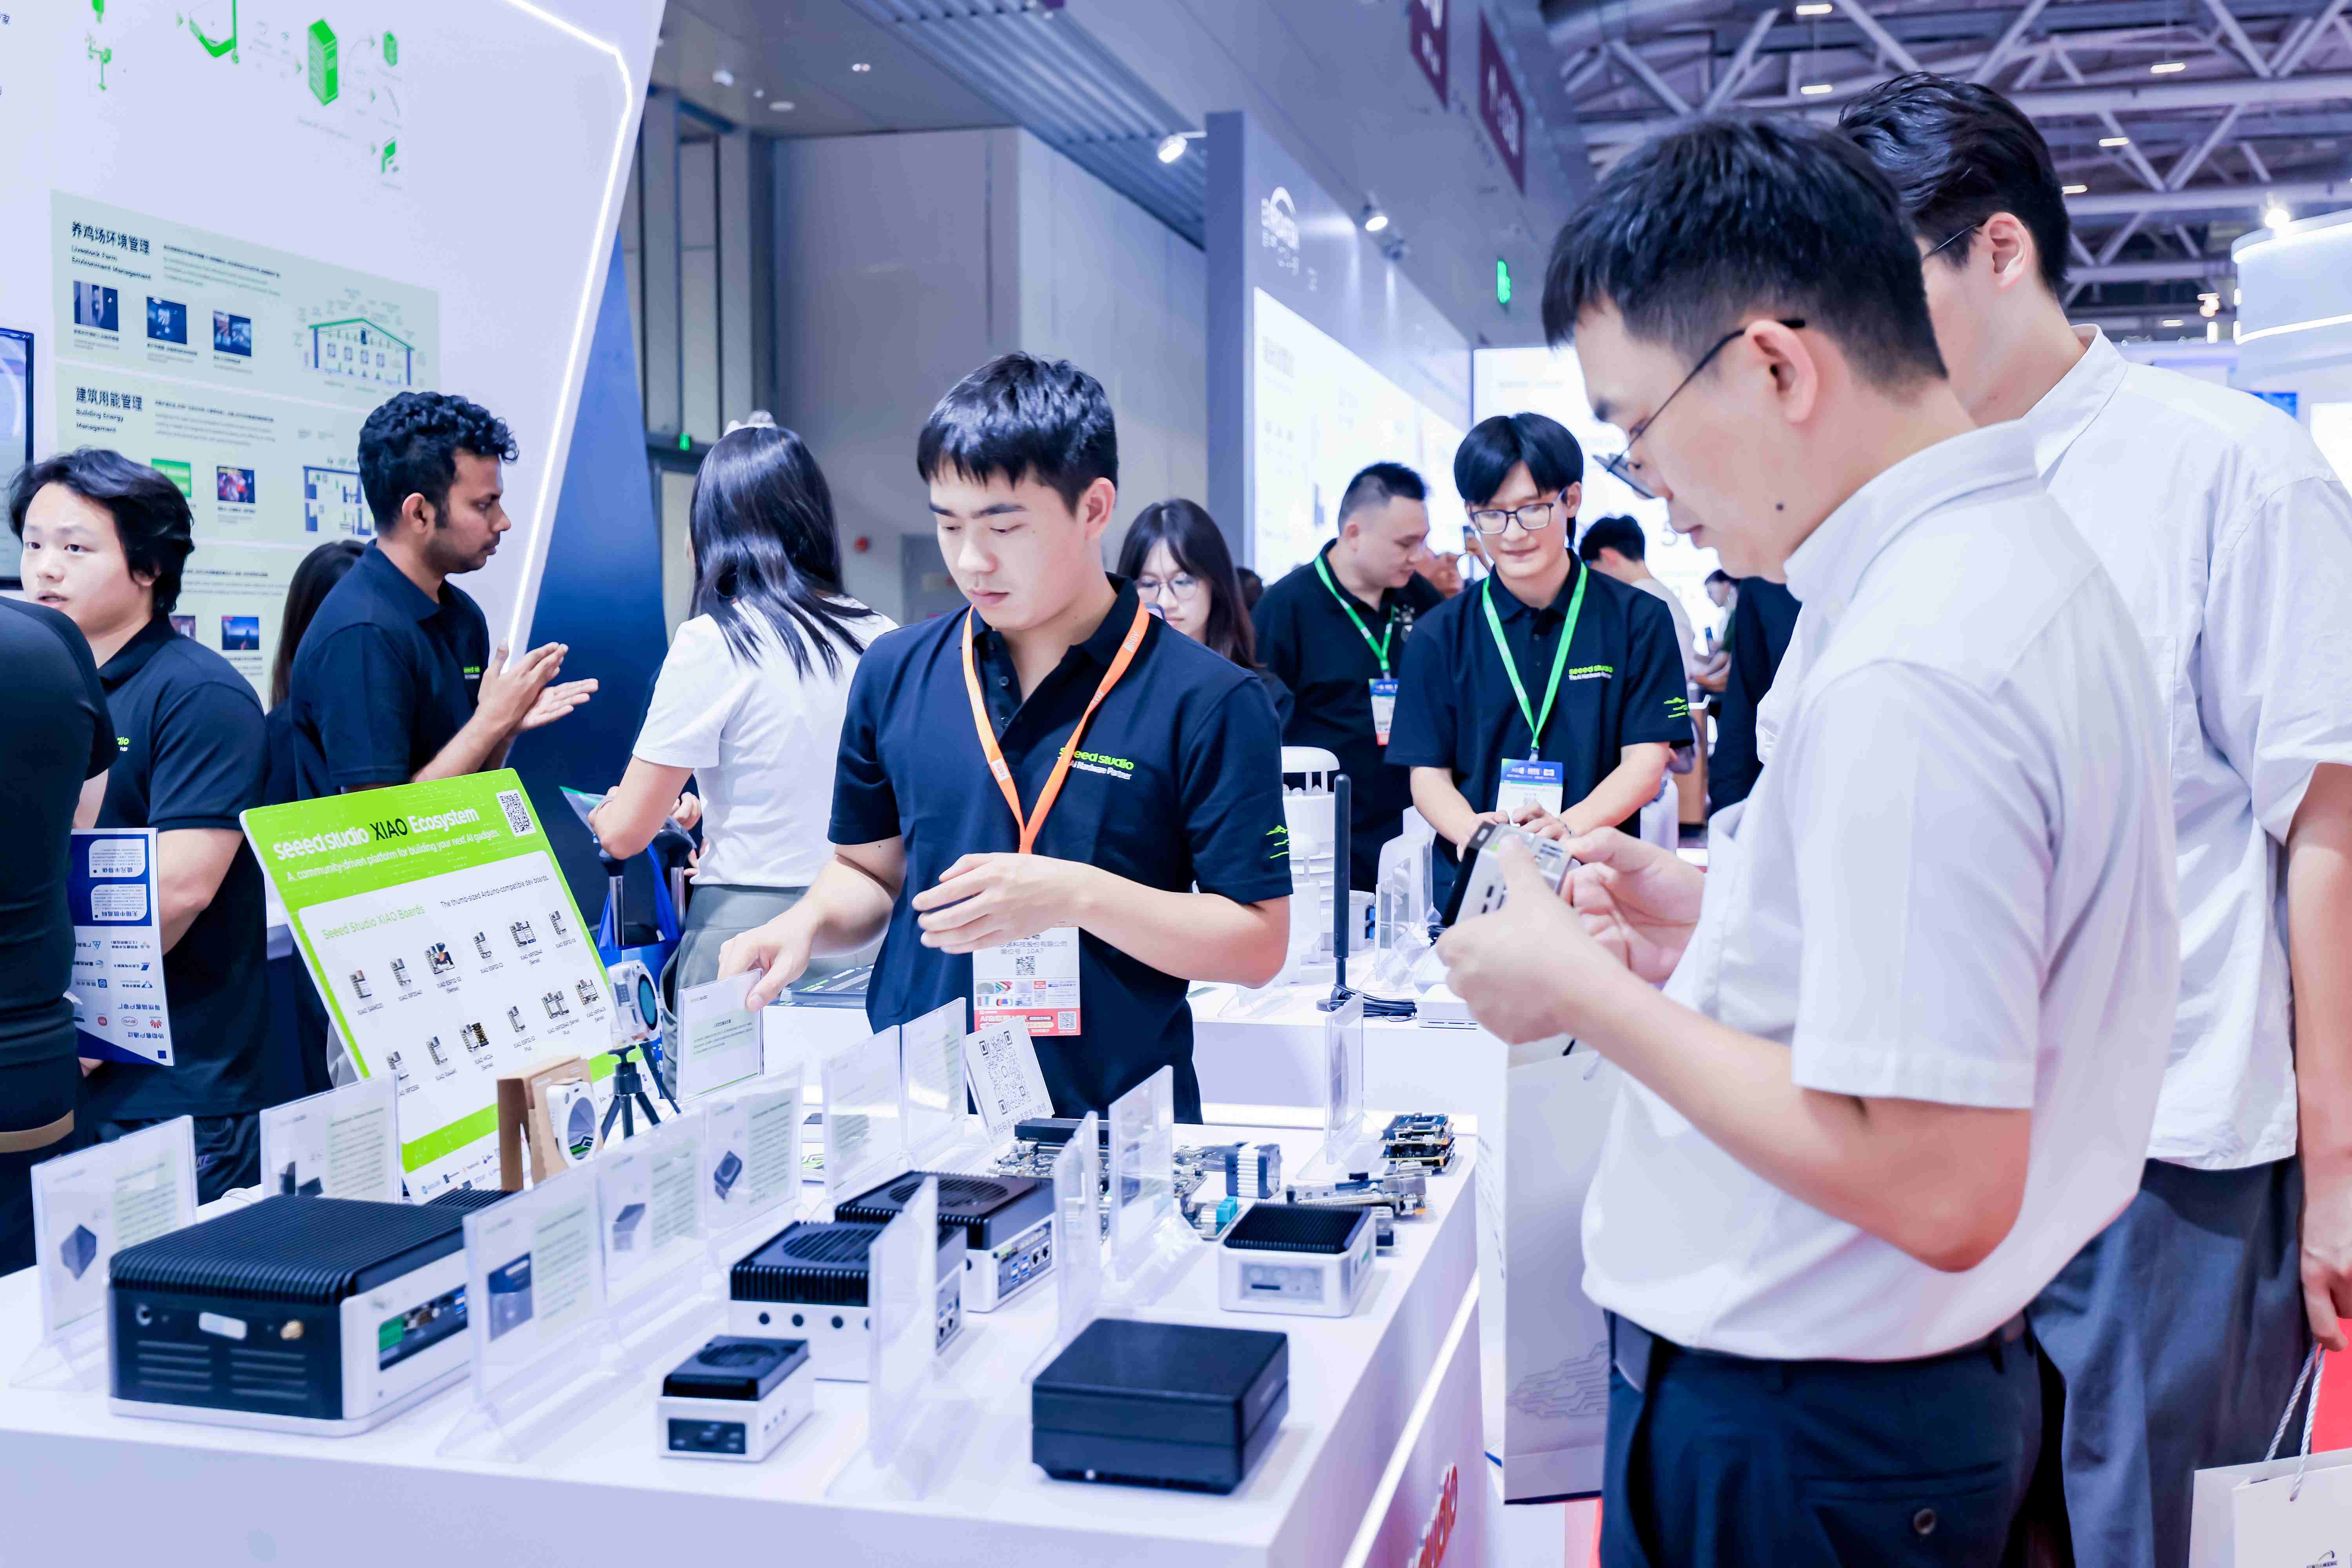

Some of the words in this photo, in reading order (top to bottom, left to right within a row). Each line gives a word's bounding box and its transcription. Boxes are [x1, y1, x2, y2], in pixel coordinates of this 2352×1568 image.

[72, 221, 150, 256] 养鸡场环境管理
[76, 387, 142, 411] 建筑用能管理
[76, 421, 116, 433] Management
[103, 412, 123, 422] Energy
[1569, 666, 1593, 675] seeed
[1059, 747, 1099, 762] seed
[1098, 754, 1134, 770] studio
[1077, 761, 1107, 774] Hardware
[1107, 767, 1132, 780] Partner
[273, 833, 327, 860] seeed
[324, 826, 370, 849] studio
[370, 818, 407, 840] XIAO
[408, 808, 480, 833] Ecosystem
[297, 857, 367, 879] community-driven
[367, 849, 398, 865] platform
[397, 848, 408, 858] for
[408, 841, 437, 856] building
[436, 838, 451, 851] your
[451, 835, 466, 846] next
[466, 833, 474, 843] AI
[451, 892, 481, 906] thumb-sized
[481, 881, 525, 898] Arduino-compatible
[322, 924, 350, 940] Seeed
[349, 917, 377, 933] Studio
[376, 911, 397, 926] XIAO
[397, 905, 425, 919] Boards
[128, 1031, 164, 1040] 协助客户通过
